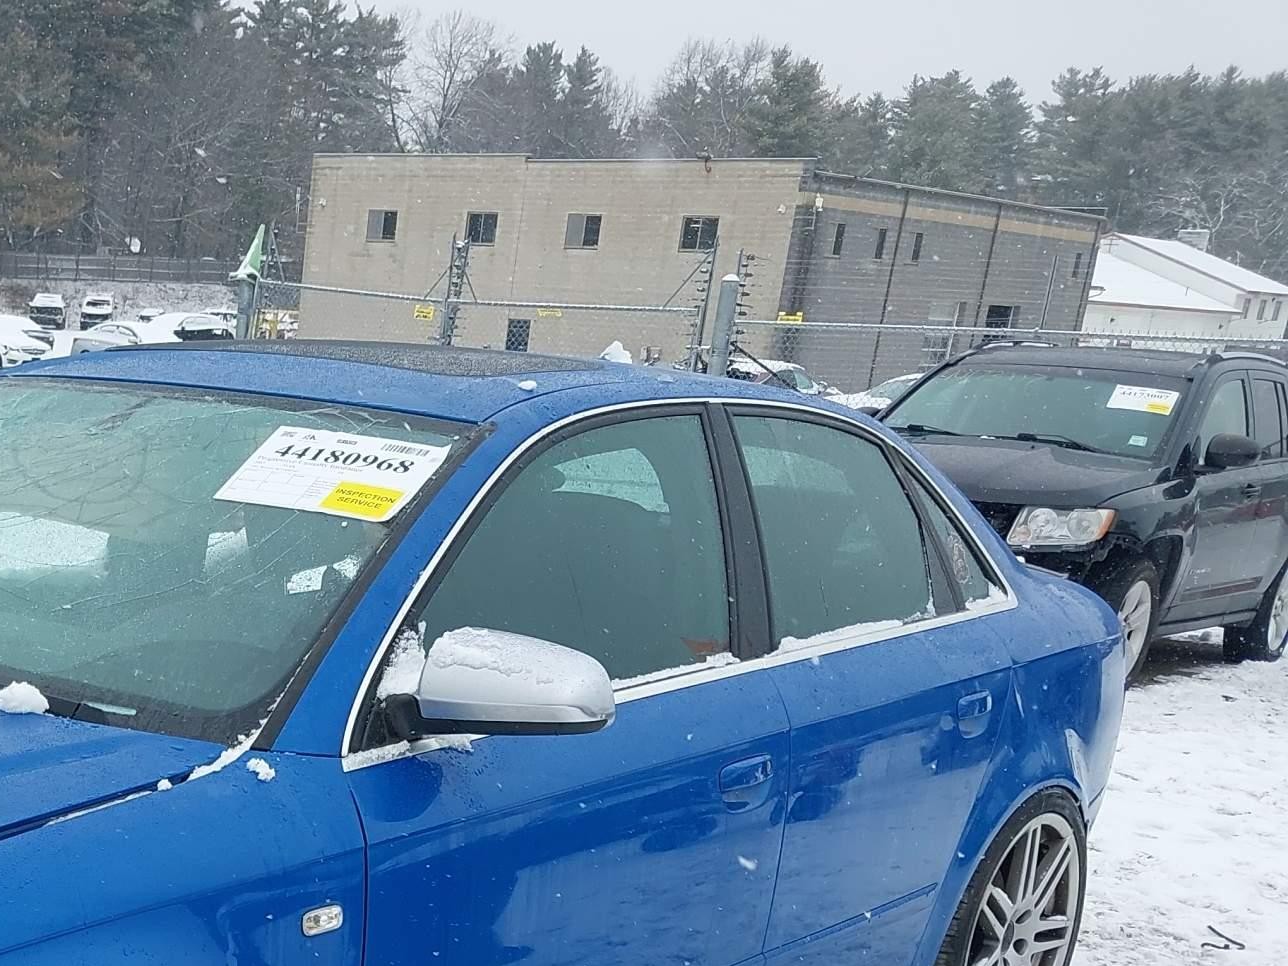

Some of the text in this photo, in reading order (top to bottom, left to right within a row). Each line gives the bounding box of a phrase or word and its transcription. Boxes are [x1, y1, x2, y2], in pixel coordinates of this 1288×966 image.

[275, 444, 415, 474] 44180968
[335, 488, 396, 504] INSPECTION
[336, 496, 383, 510] SERVICE
